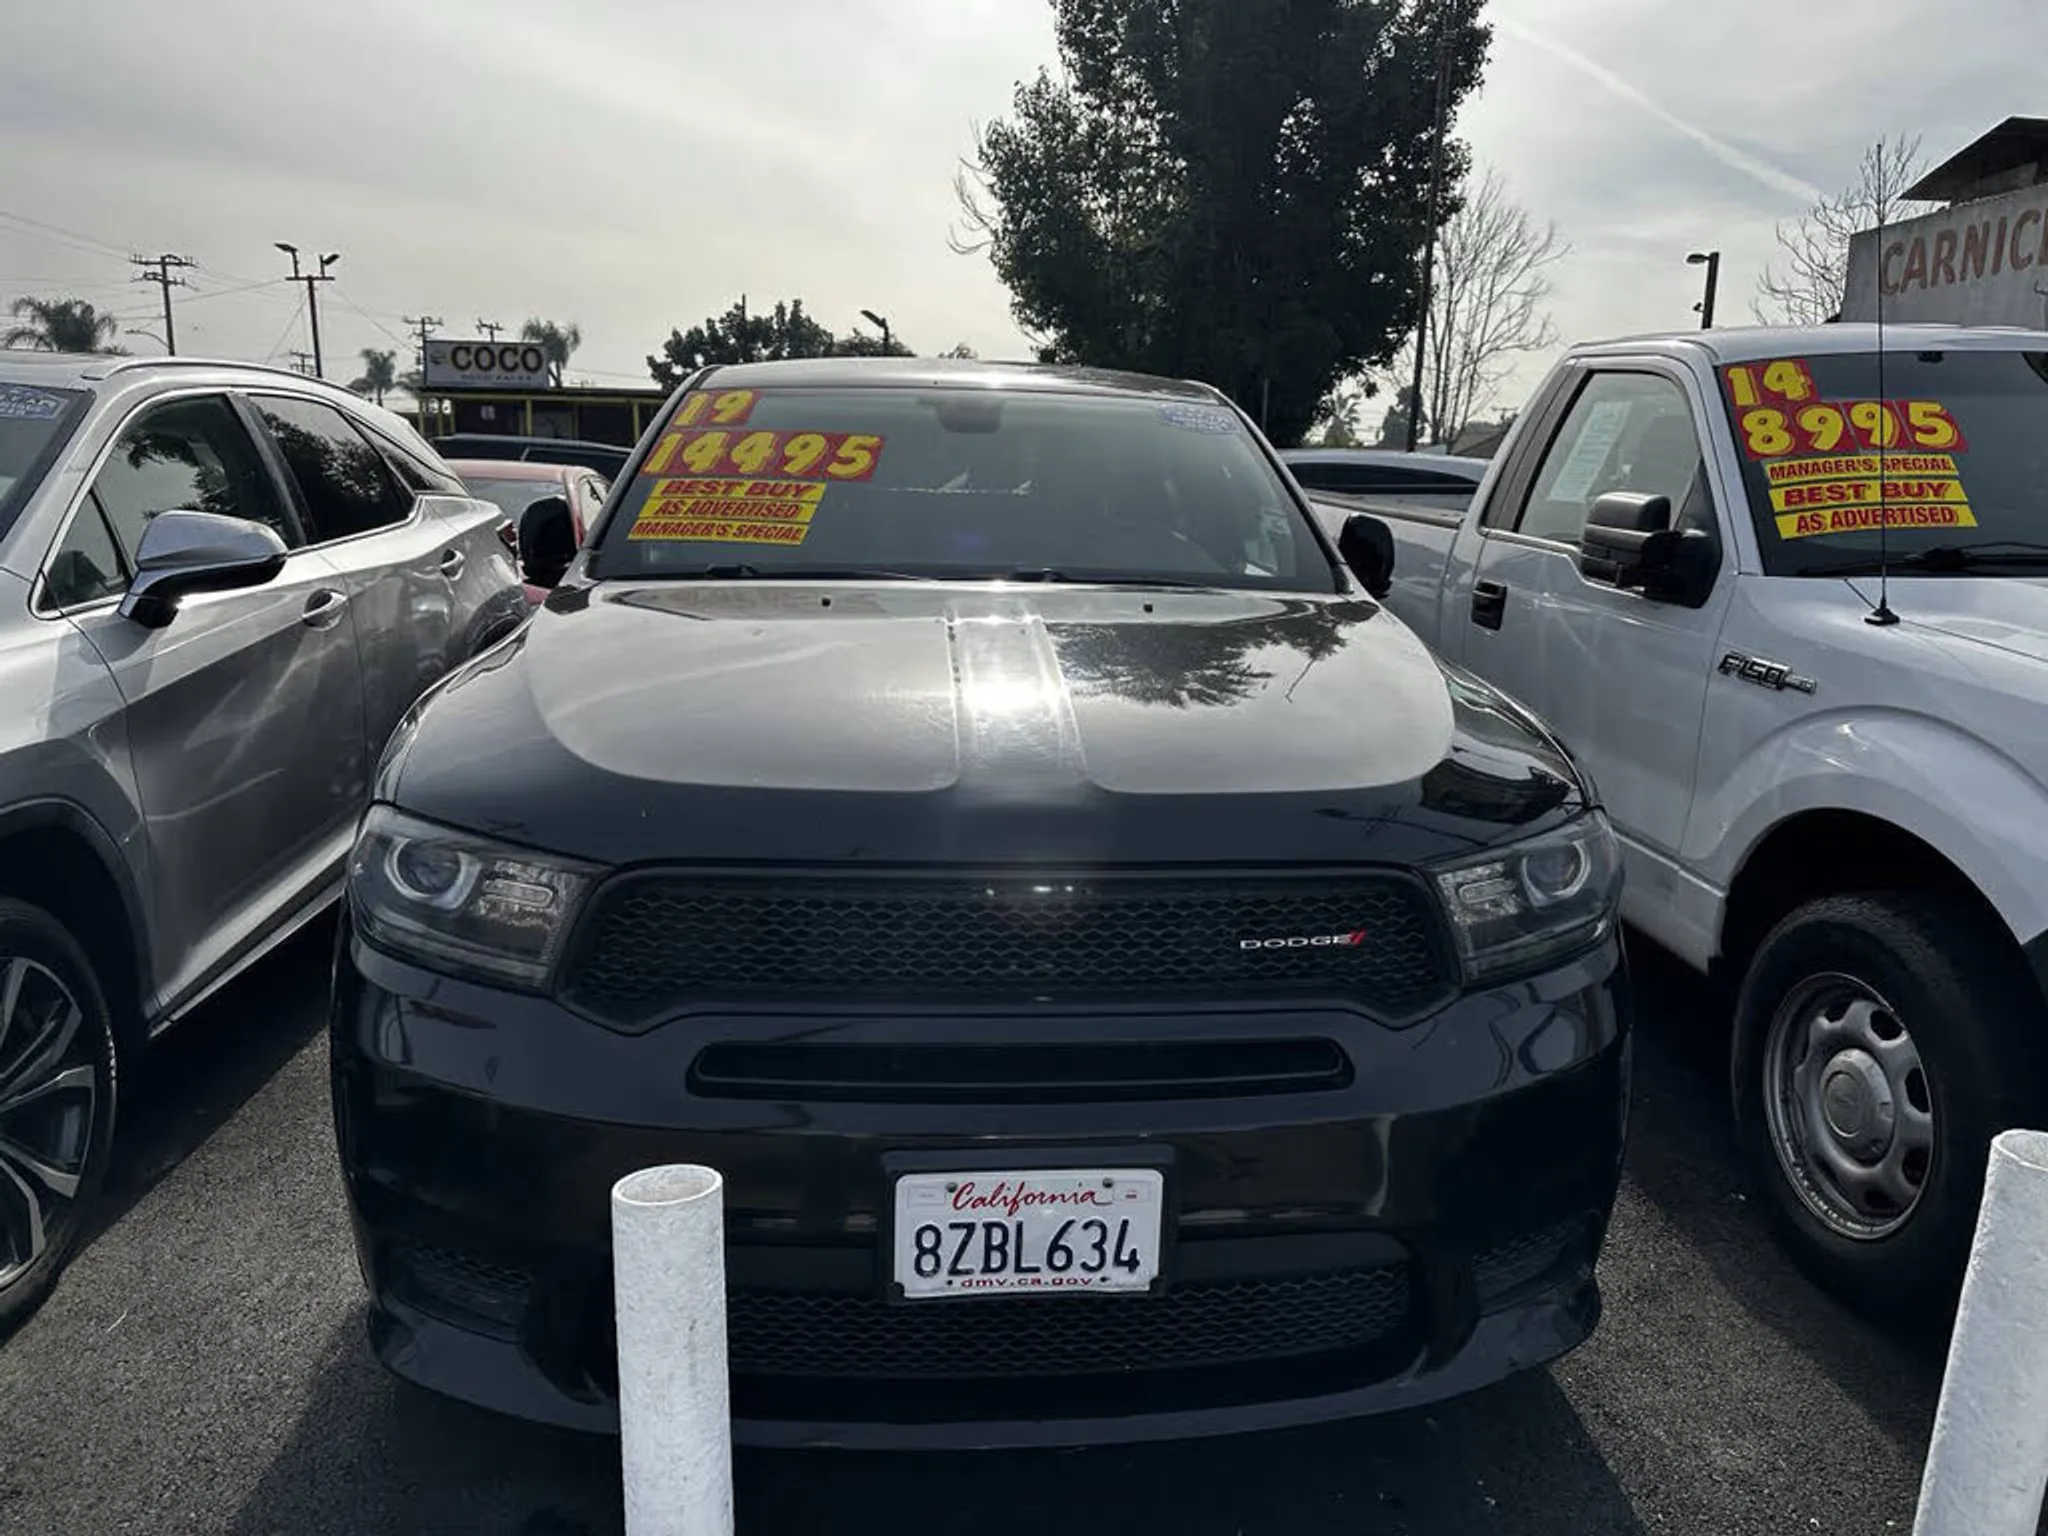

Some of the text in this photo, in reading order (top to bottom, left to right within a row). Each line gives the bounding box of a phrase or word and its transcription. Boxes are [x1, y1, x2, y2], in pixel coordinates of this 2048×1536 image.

[451, 345, 543, 372] COCO
[1727, 360, 1811, 406] 14
[673, 390, 753, 426] 19
[1741, 401, 1959, 454] 8995
[642, 431, 881, 479] 14495
[1768, 458, 1877, 480] MANAGER'S
[660, 480, 815, 498] BEST BUY
[1783, 481, 1949, 507] BEST BUY
[654, 500, 801, 518] AS ADVERTISED
[1796, 506, 1957, 533] AS ADVERTISED
[732, 525, 803, 541] SPECIAL
[1240, 934, 1351, 949] DODGE
[951, 1181, 1100, 1217] California
[913, 1218, 1141, 1278] 8ZBL634
[960, 1275, 1092, 1288] dmv.ca.gov
